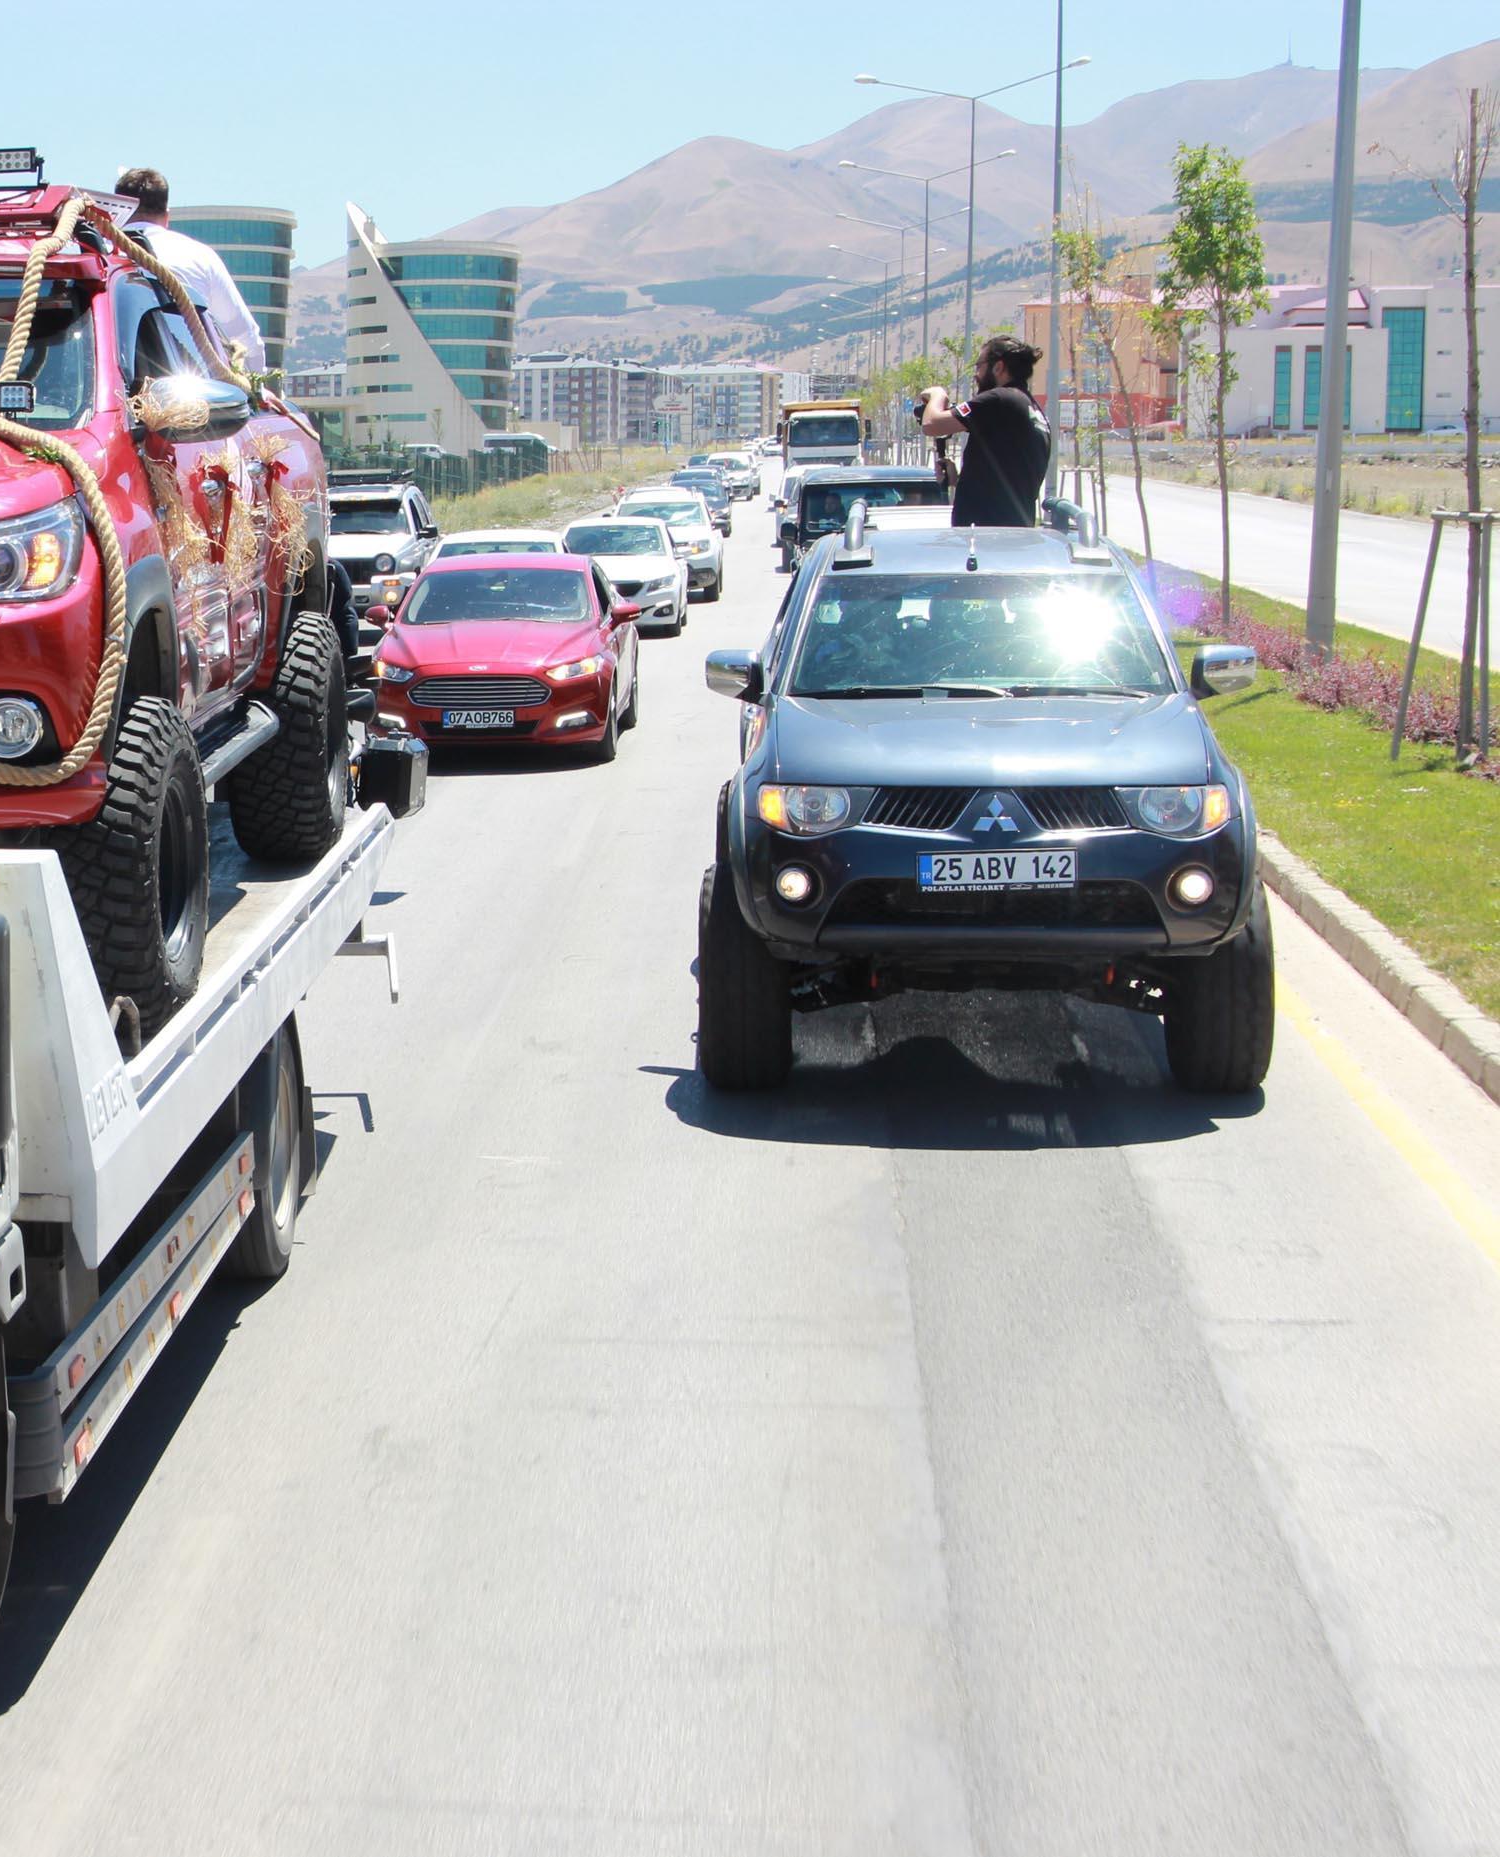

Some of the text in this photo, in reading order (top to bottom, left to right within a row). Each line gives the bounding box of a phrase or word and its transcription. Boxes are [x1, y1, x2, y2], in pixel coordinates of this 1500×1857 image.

[934, 858, 963, 881] 25
[973, 856, 1016, 880] ABV
[1032, 855, 1072, 879] 142
